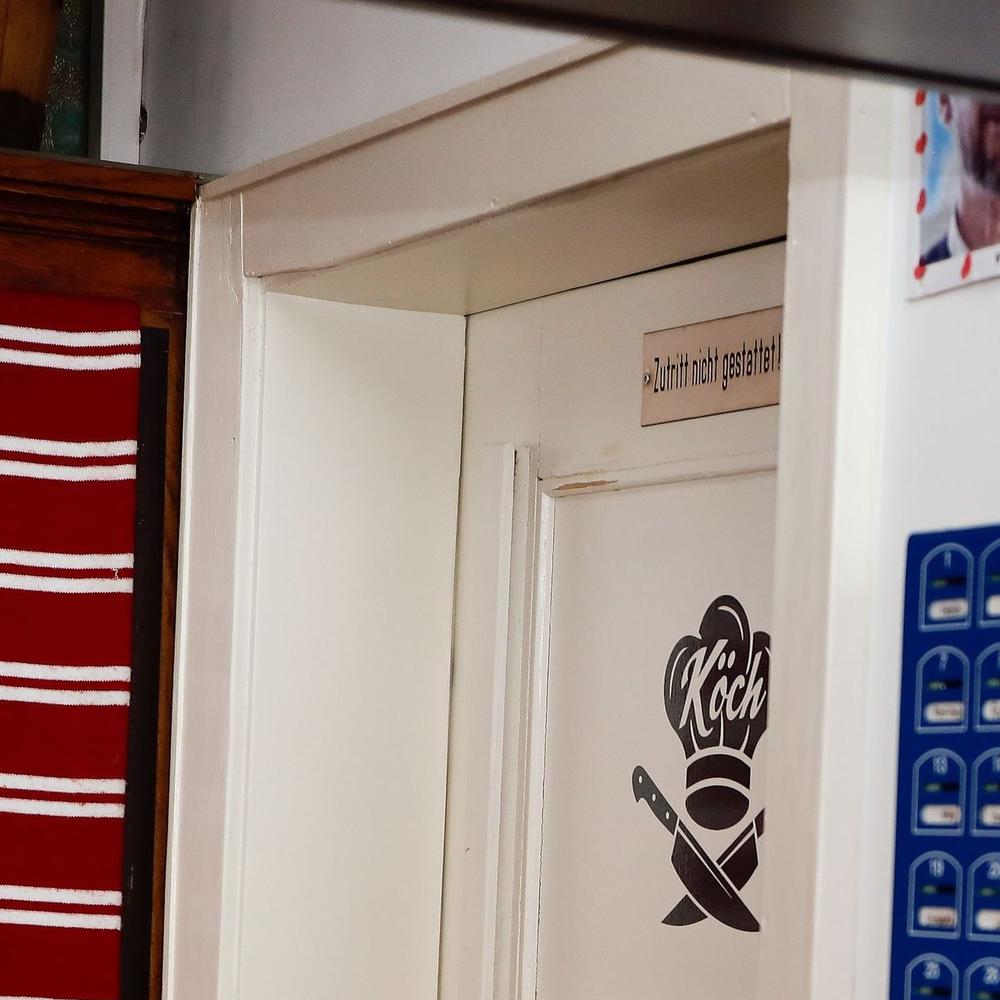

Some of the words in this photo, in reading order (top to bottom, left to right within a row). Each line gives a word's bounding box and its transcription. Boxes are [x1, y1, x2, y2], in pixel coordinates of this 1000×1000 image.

[653, 353, 689, 393] Zutritt
[692, 346, 719, 387] nicht
[678, 638, 767, 738] Köch
